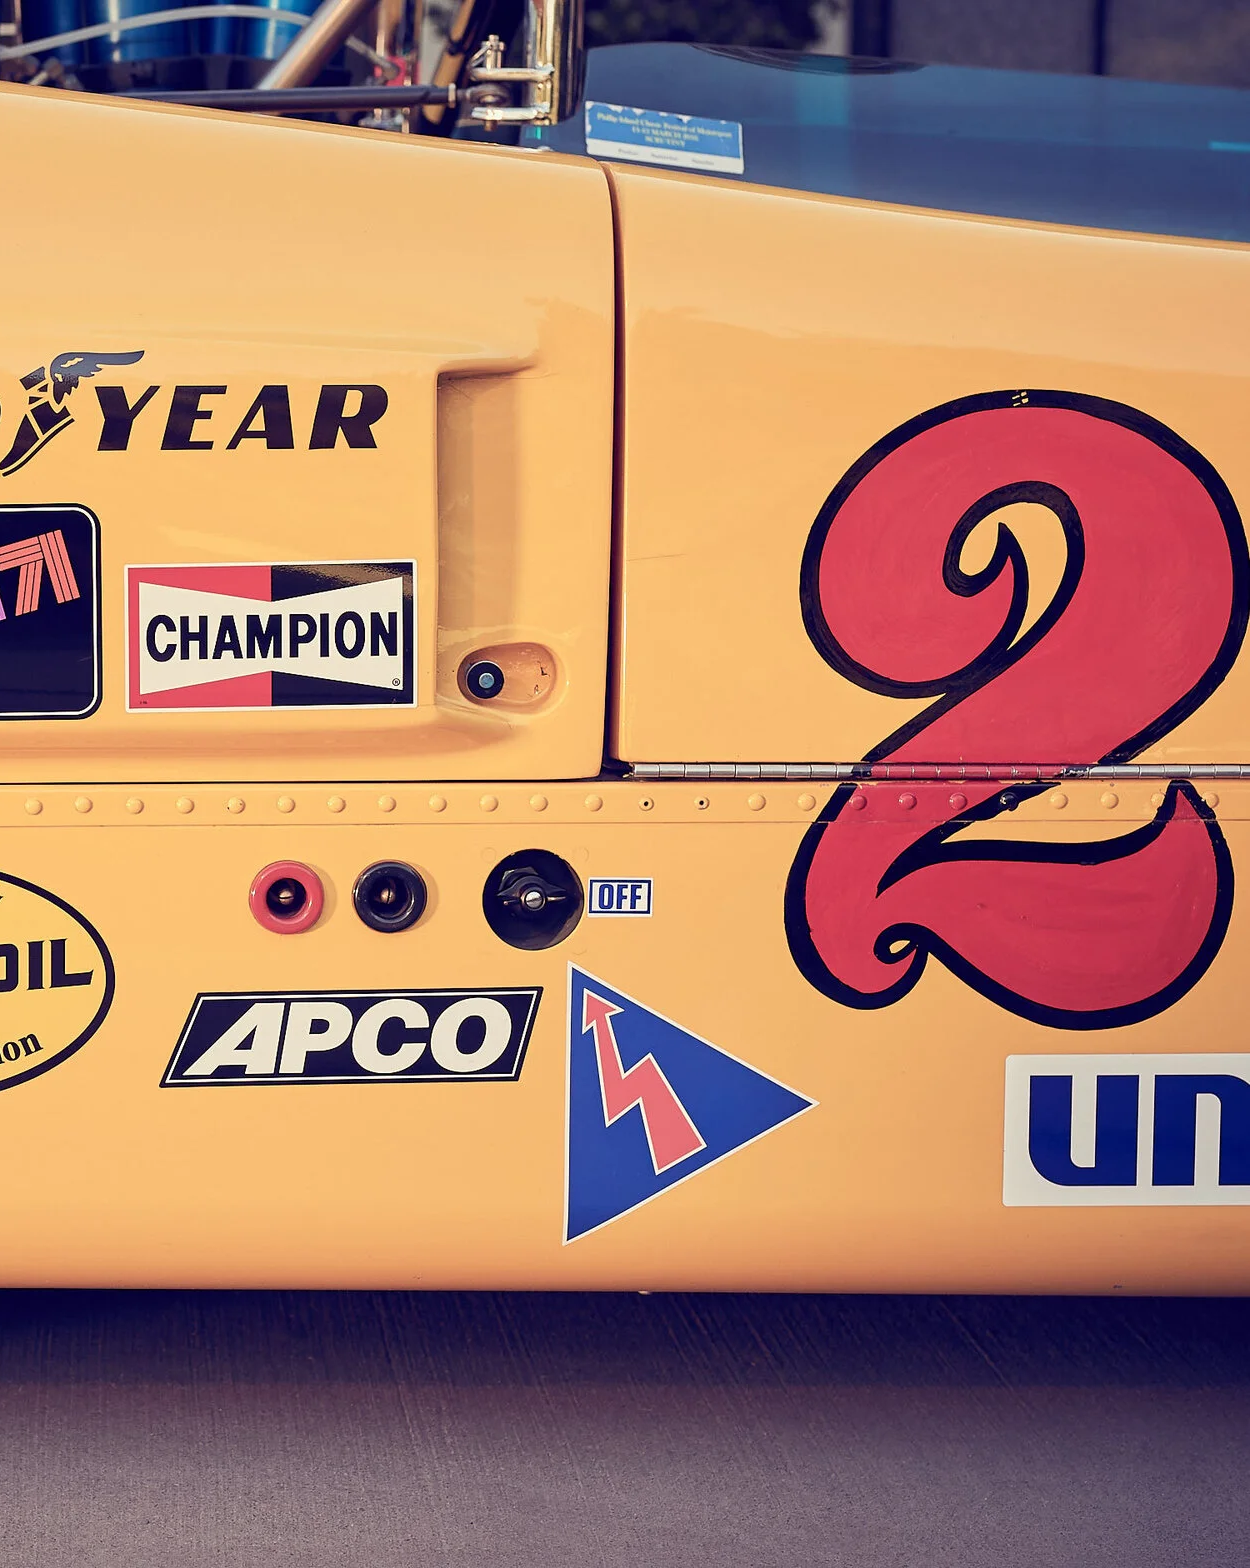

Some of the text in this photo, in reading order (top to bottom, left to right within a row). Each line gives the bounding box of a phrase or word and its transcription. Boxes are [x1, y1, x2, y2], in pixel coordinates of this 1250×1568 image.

[145, 610, 398, 663] CHAMPION
[784, 388, 1250, 1031] 2
[598, 884, 643, 910] OFF
[183, 997, 513, 1075] APCO
